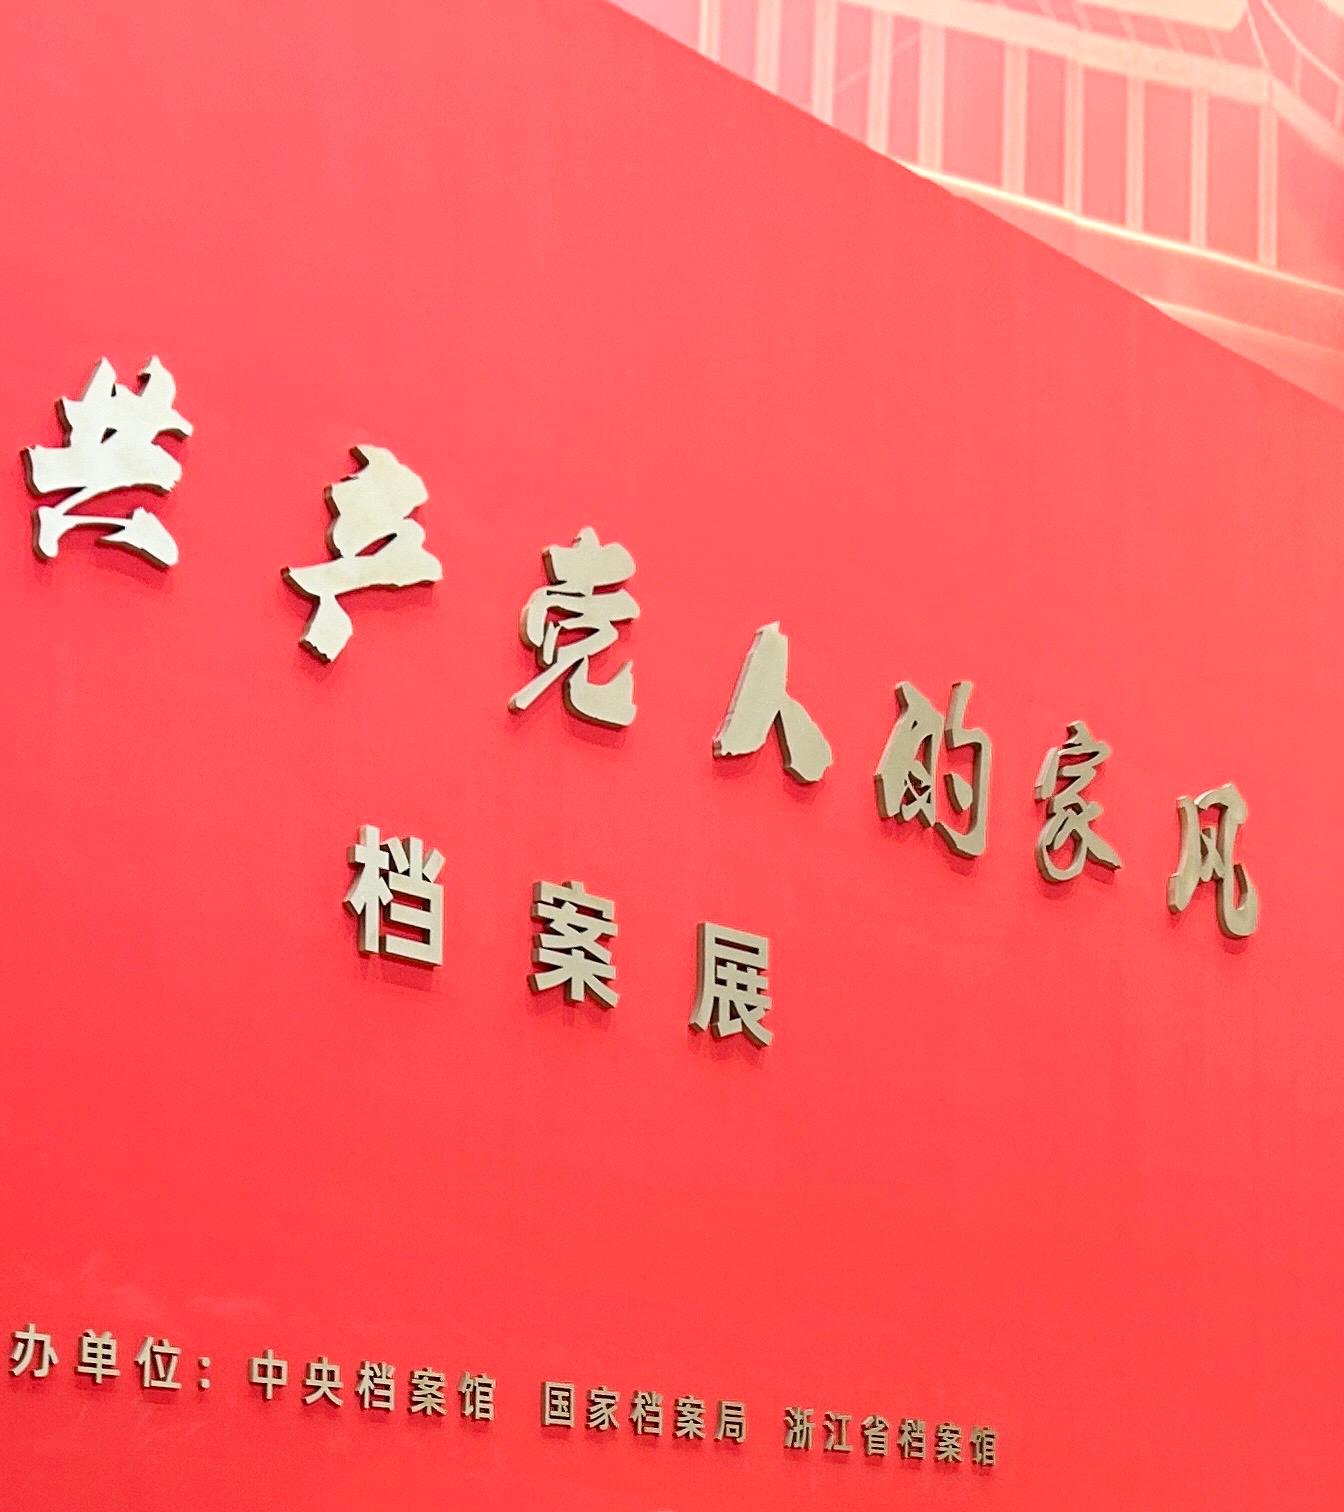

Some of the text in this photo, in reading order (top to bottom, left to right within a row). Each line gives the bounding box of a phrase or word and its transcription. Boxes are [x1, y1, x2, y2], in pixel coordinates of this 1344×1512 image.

[344, 824, 773, 1047] 档案展
[542, 1381, 747, 1443] 国家档案局
[784, 1406, 998, 1466] 浙江省档案馆
